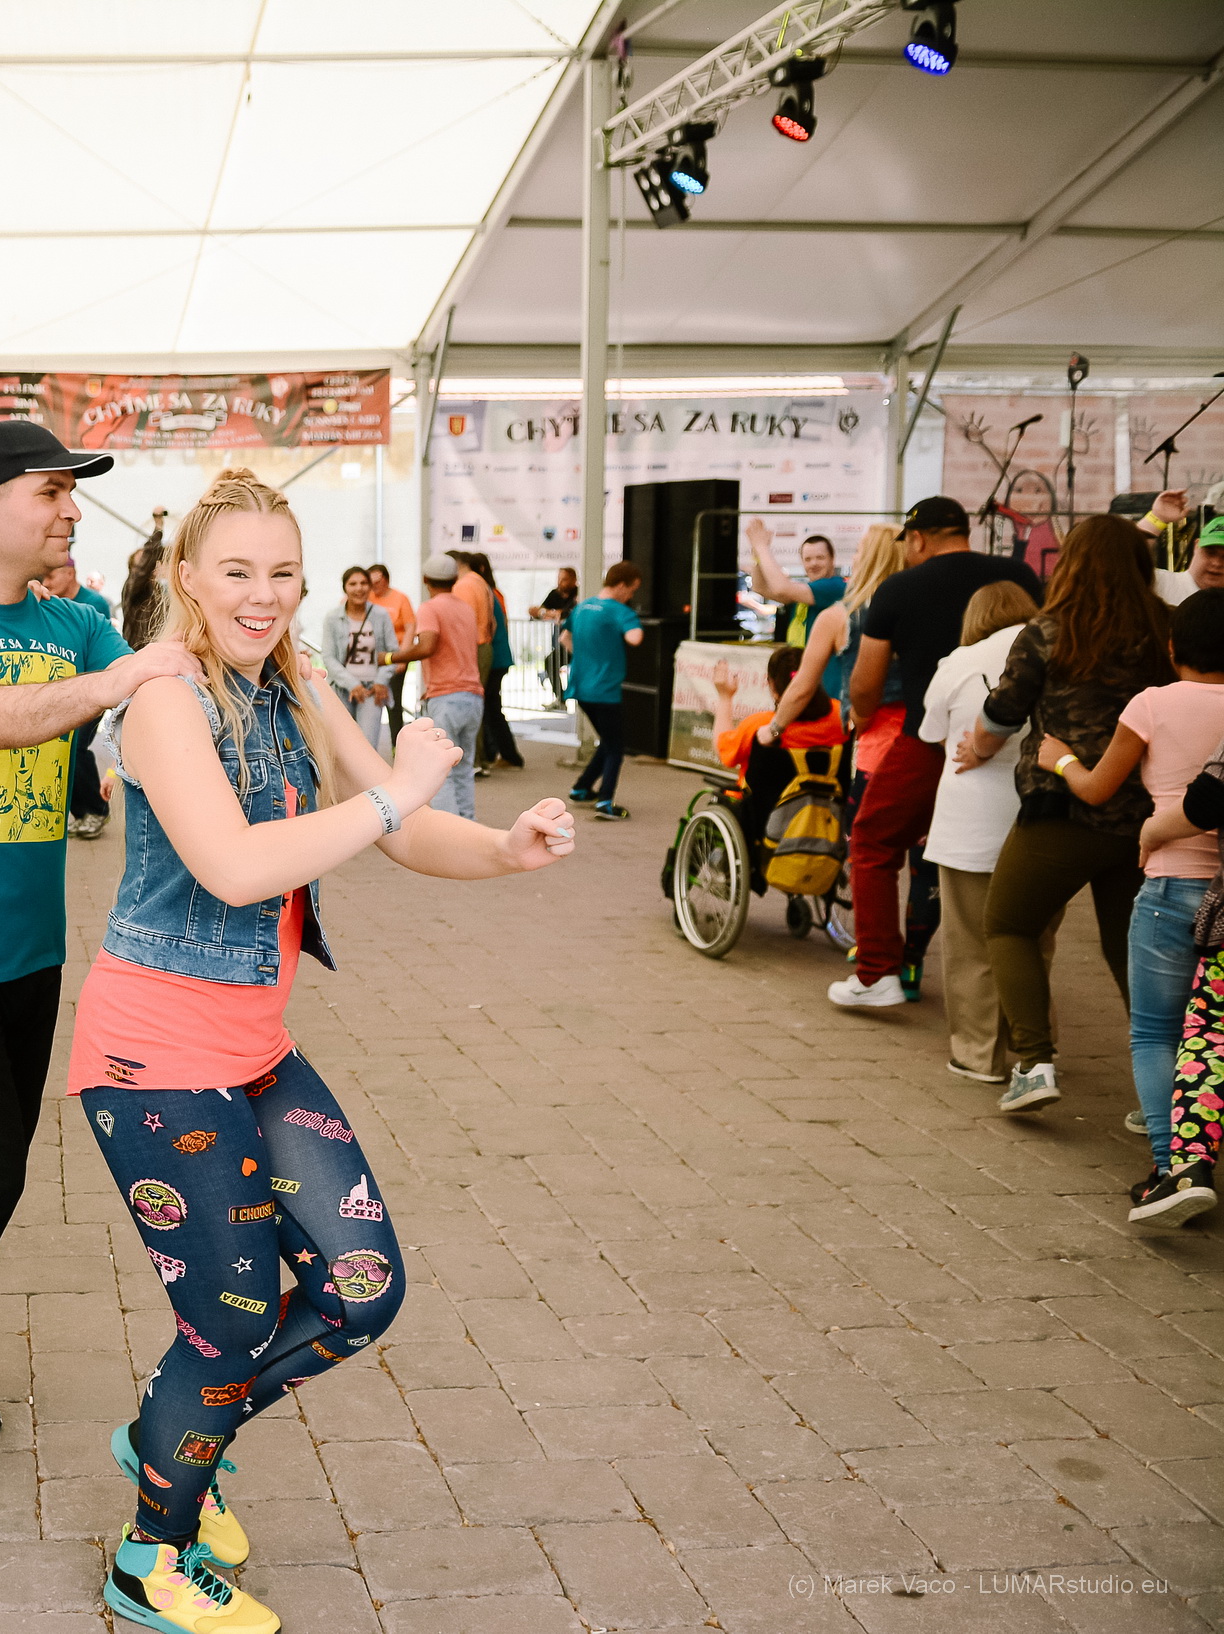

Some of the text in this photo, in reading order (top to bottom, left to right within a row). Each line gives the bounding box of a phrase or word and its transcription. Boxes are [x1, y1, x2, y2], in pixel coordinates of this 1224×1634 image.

[168, 392, 192, 409] SA
[202, 393, 227, 411] ZA
[233, 396, 286, 426] RUKY
[507, 408, 808, 443] CHYŤE SA ZA RUKY
[8, 638, 23, 649] SA
[29, 638, 45, 652] ZA
[46, 642, 77, 662] RUKY
[283, 1108, 354, 1143] 100% Real
[271, 1180, 298, 1192] MBA
[239, 1203, 273, 1221] CHOOSE
[340, 1207, 381, 1219] THIS
[356, 1199, 381, 1210] GOT
[222, 1293, 265, 1313] ZUMBA
[190, 1433, 221, 1443] FEMALE
[178, 1454, 210, 1465] FIERCE
